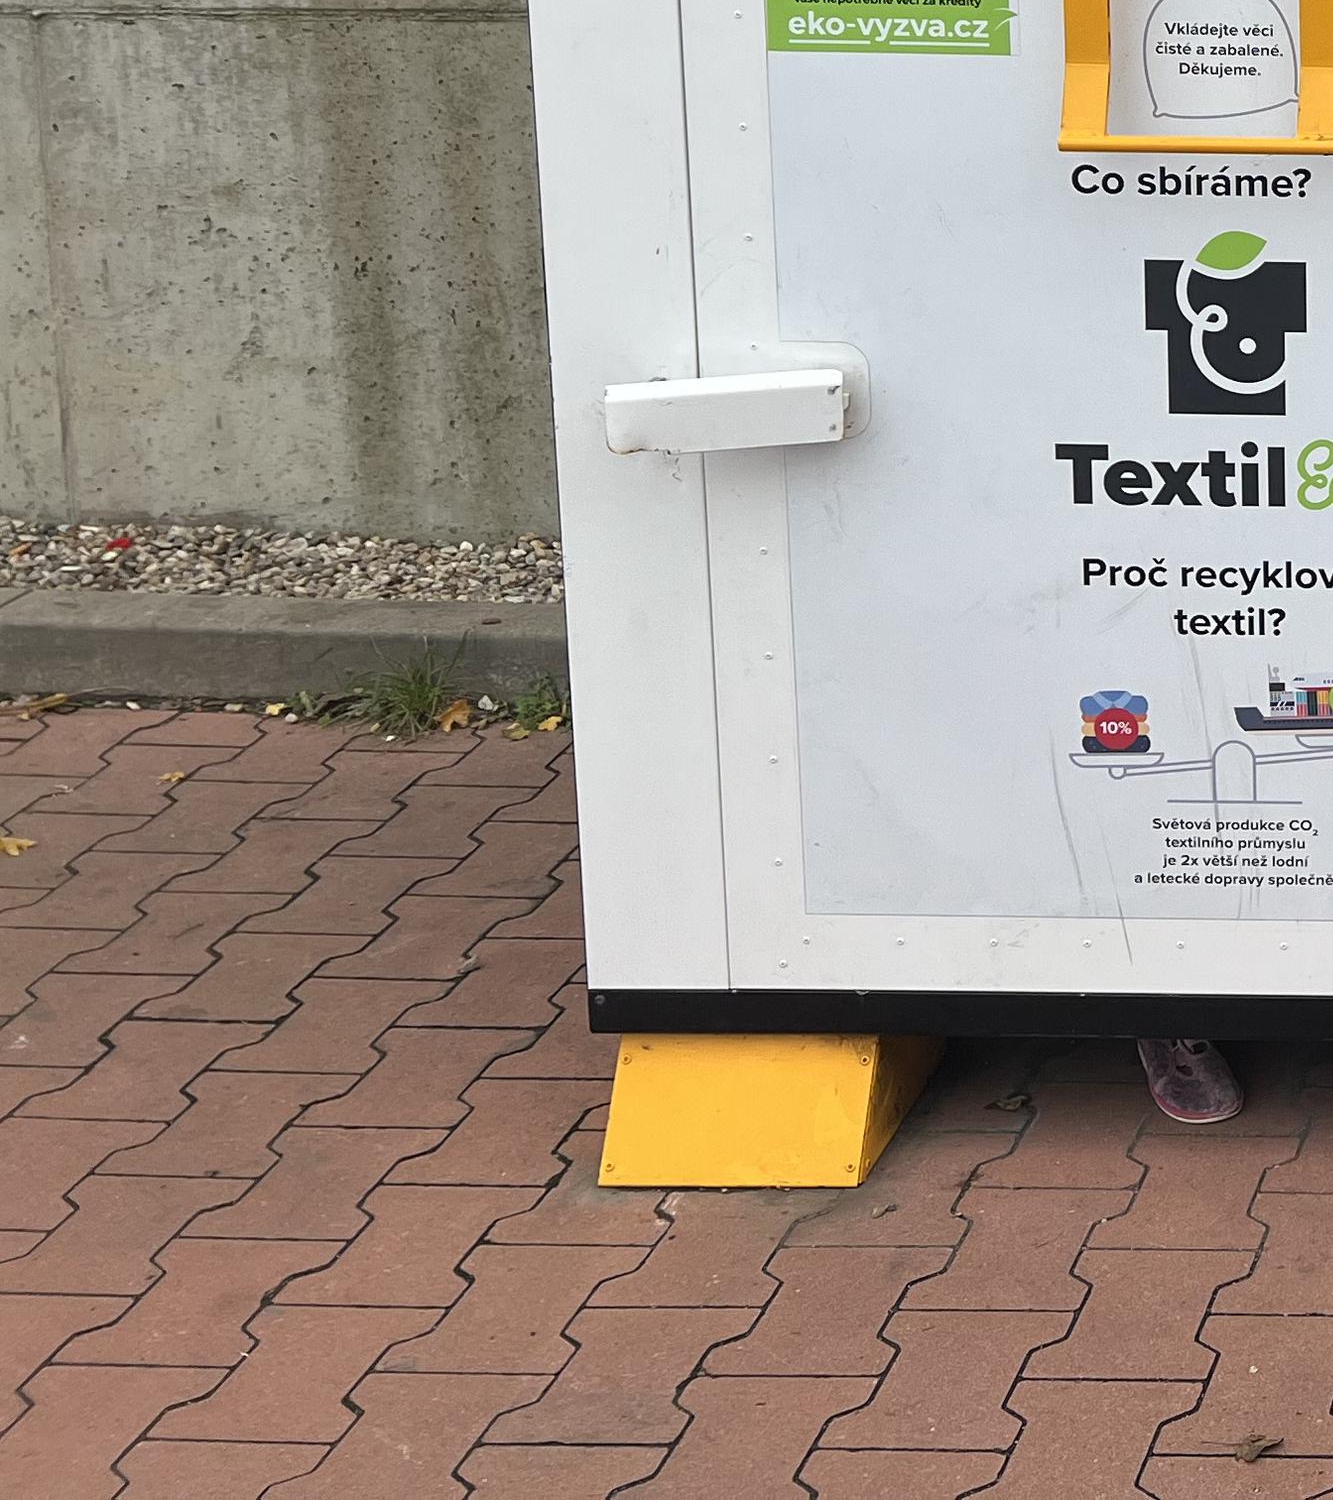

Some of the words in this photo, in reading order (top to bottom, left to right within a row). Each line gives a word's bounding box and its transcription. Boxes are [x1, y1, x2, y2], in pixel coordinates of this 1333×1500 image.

[788, 11, 989, 42] eko-vyzva.cz
[1164, 22, 1238, 39] Vkládejte
[1242, 23, 1274, 37] věci
[1155, 41, 1192, 55] čisté
[1196, 46, 1205, 55] a
[1209, 43, 1284, 57] zabalené.
[1178, 62, 1262, 78] Děkujeme.
[1071, 164, 1125, 196] Co
[1137, 165, 1313, 198] sbíráme?
[1082, 557, 1168, 588] Proč
[1174, 607, 1287, 637] textil?
[1099, 720, 1133, 736] 10%
[1152, 817, 1212, 830] Světová
[1216, 819, 1285, 832] produkce
[1165, 836, 1234, 848] textilního
[1238, 836, 1306, 851] průmyslu
[1162, 854, 1177, 868] je
[1181, 855, 1199, 866] 2x
[1203, 854, 1238, 866] větší
[1242, 855, 1268, 867] než
[1272, 855, 1309, 867] lodní
[1134, 875, 1143, 884] a
[1148, 872, 1200, 884] letecké
[1204, 873, 1264, 887] dopravy
